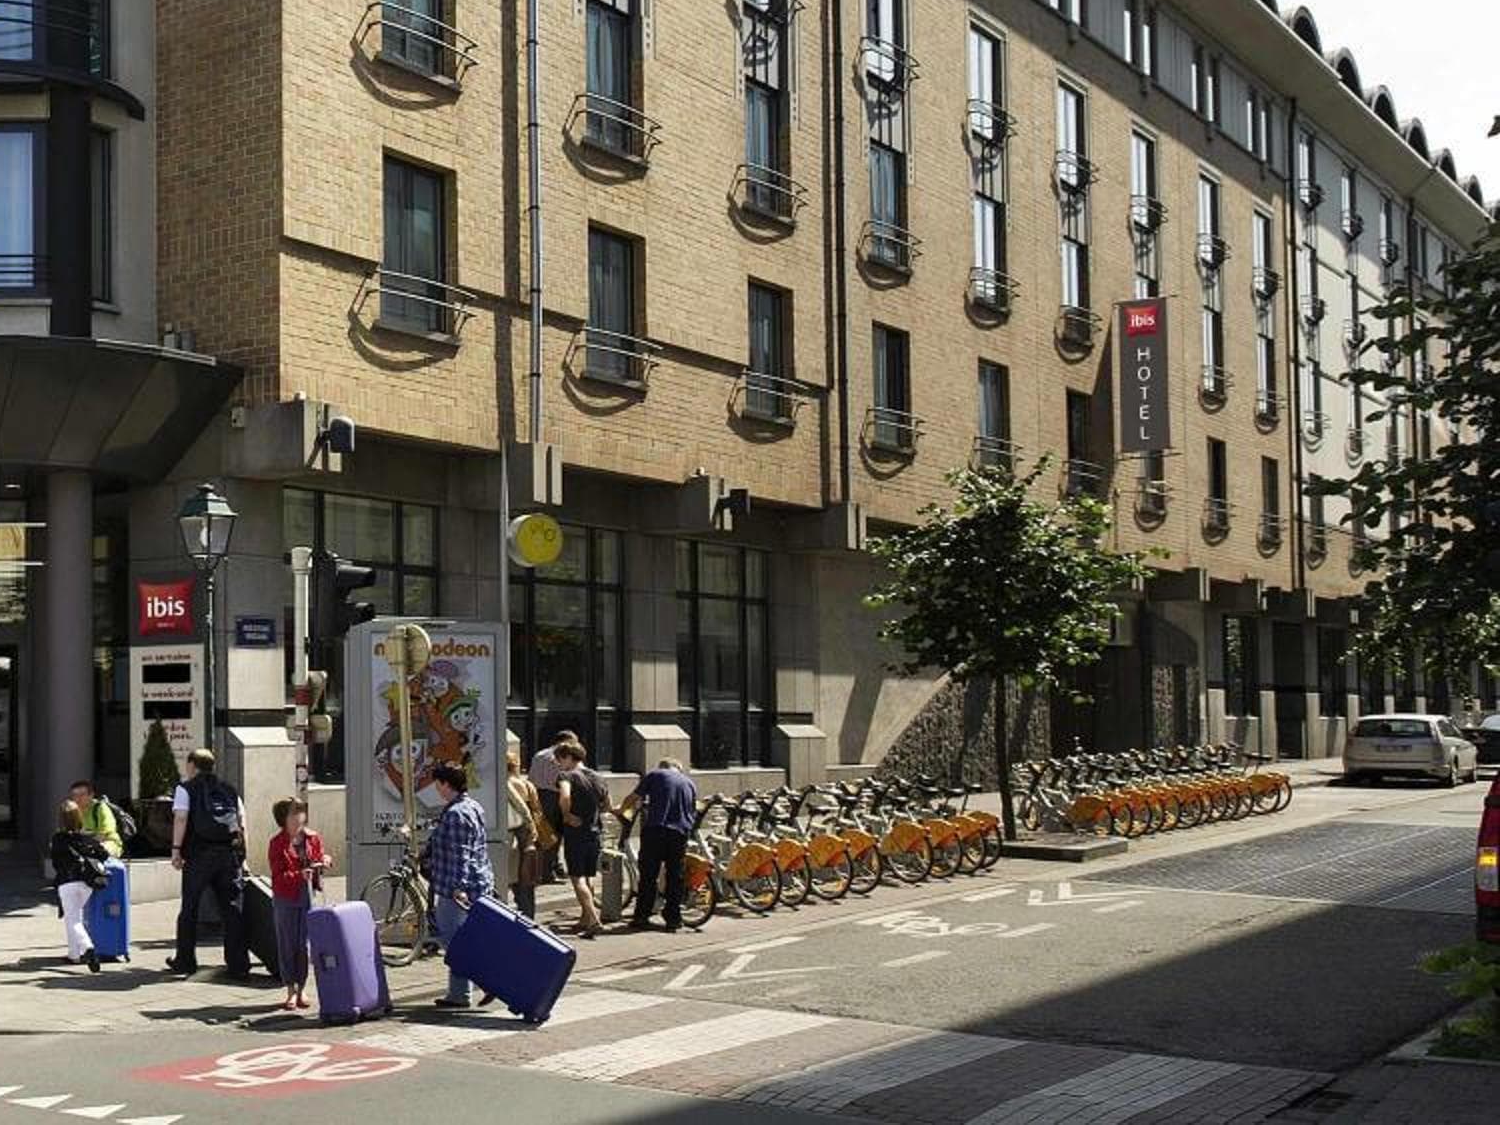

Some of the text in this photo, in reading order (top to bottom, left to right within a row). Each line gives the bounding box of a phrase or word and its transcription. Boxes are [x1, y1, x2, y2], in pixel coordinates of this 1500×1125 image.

[1131, 314, 1156, 328] ibis
[1136, 346, 1152, 441] HOTEL
[146, 596, 186, 619] ibis
[374, 637, 490, 657] nodeon
